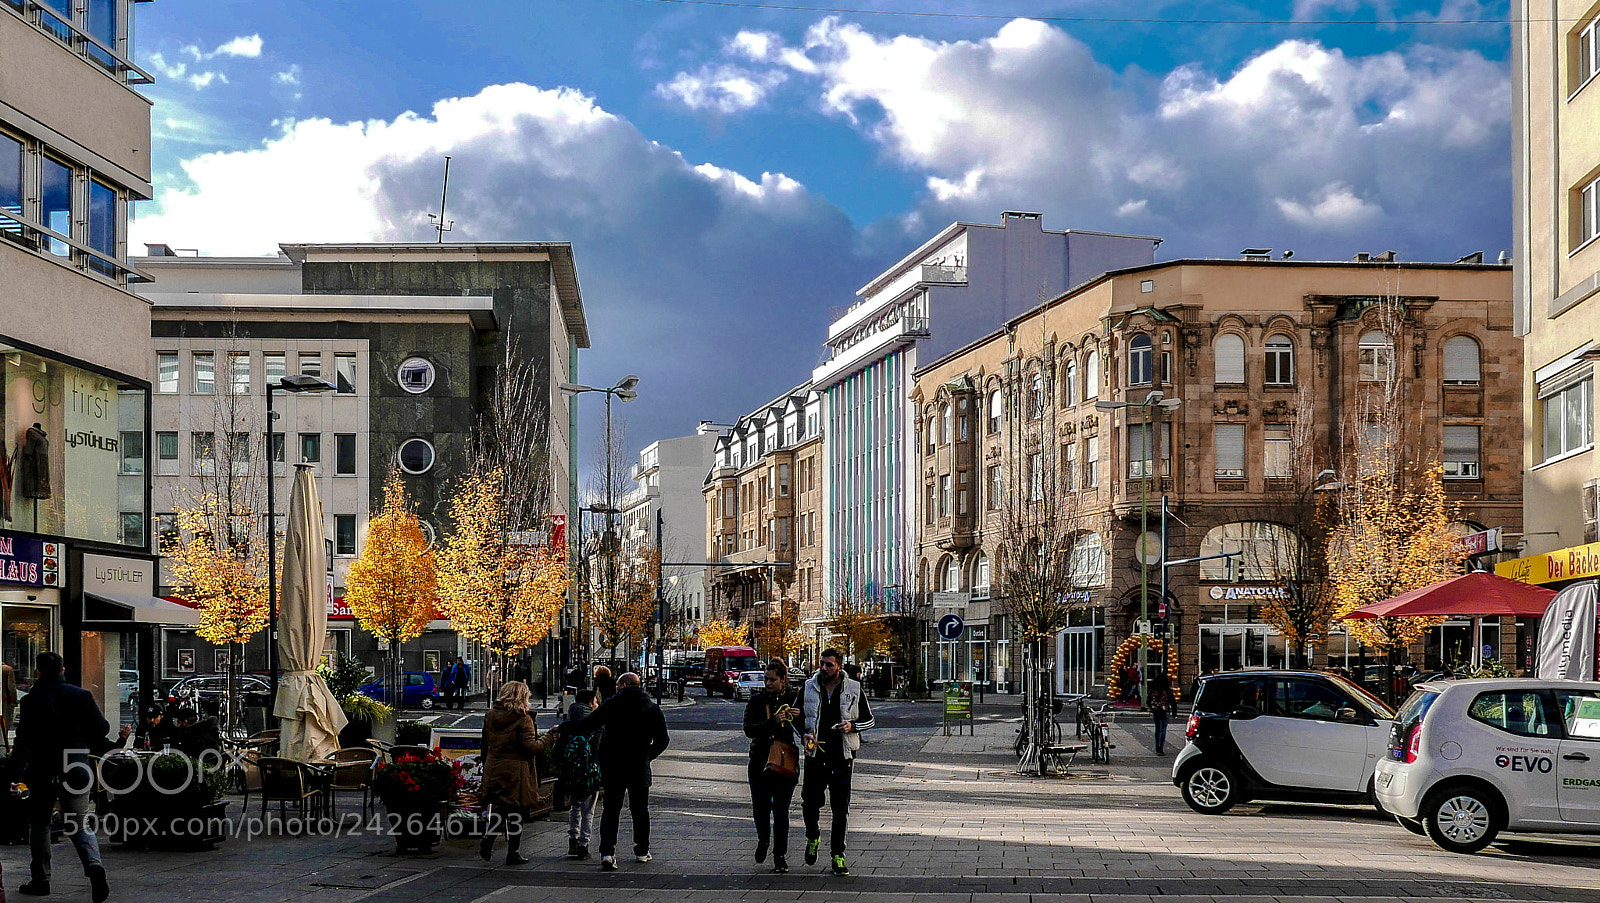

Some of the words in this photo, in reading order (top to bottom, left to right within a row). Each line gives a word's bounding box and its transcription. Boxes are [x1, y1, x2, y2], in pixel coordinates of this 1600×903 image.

[72, 374, 109, 420] first
[1547, 555, 1564, 579] Der
[1512, 755, 1553, 773] EVO
[1562, 778, 1600, 787] ERDGAS
